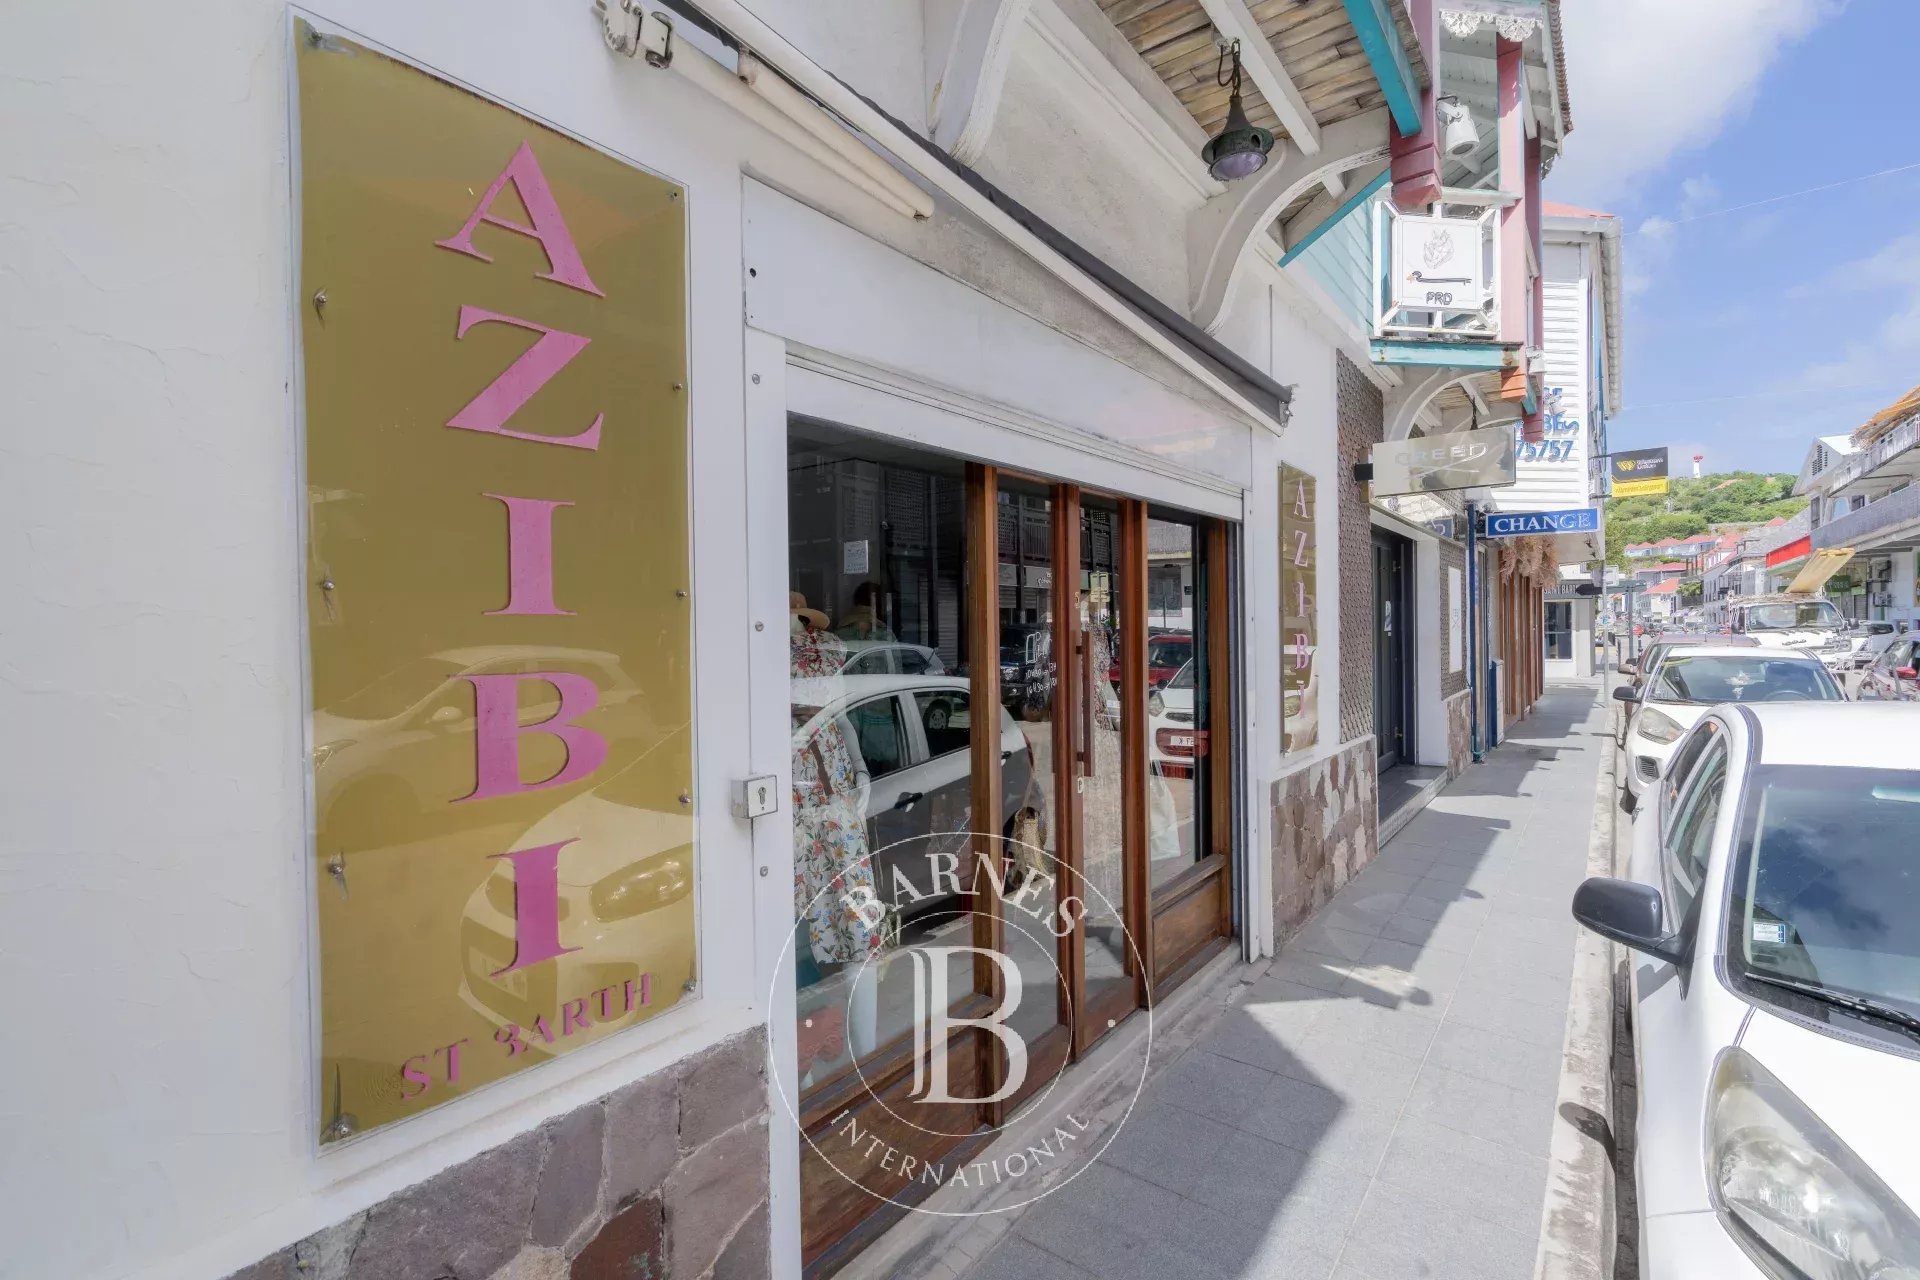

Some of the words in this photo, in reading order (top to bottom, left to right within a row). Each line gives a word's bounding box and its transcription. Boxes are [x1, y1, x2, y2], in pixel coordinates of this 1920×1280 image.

[436, 138, 608, 979] AZIBI
[1494, 512, 1591, 532] CHANGE
[1293, 479, 1309, 720] AZIBI
[401, 1037, 471, 1100] ST
